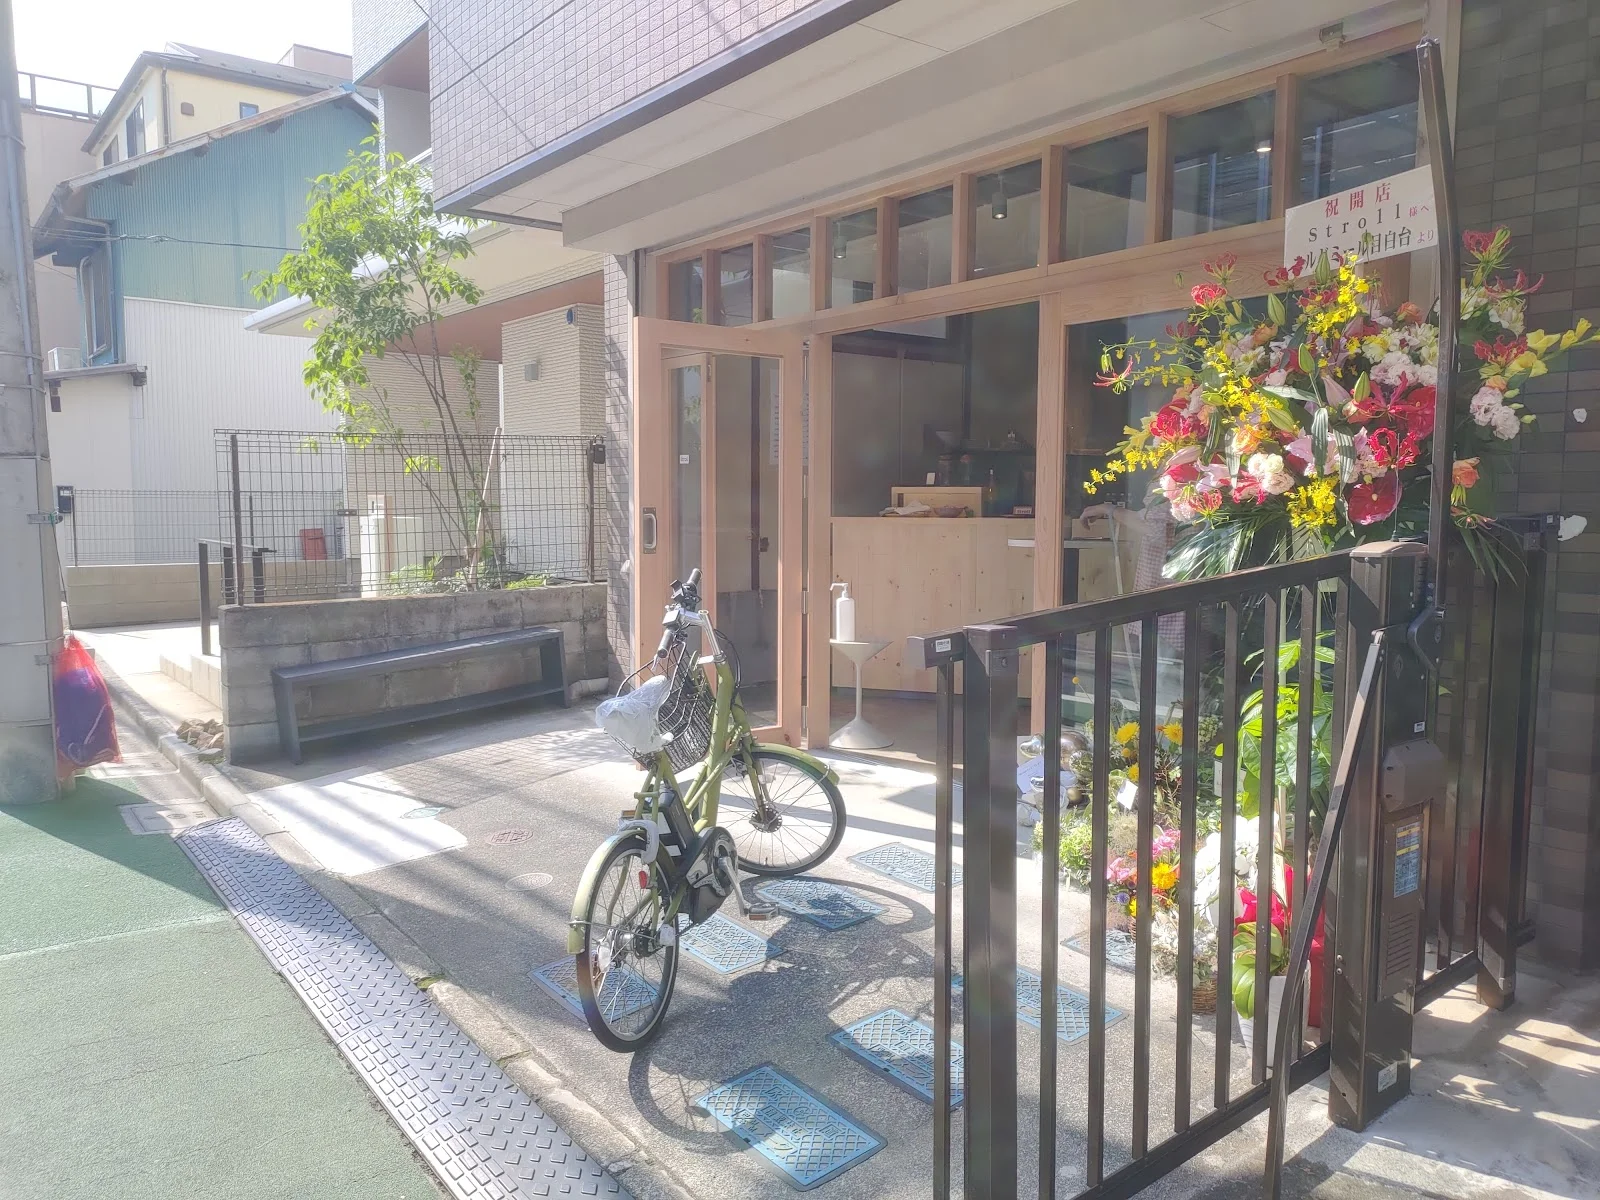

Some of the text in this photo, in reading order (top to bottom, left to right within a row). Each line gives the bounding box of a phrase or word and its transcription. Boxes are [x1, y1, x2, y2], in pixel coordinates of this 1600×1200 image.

[1325, 182, 1391, 218] 祝開店
[1417, 229, 1434, 244] より
